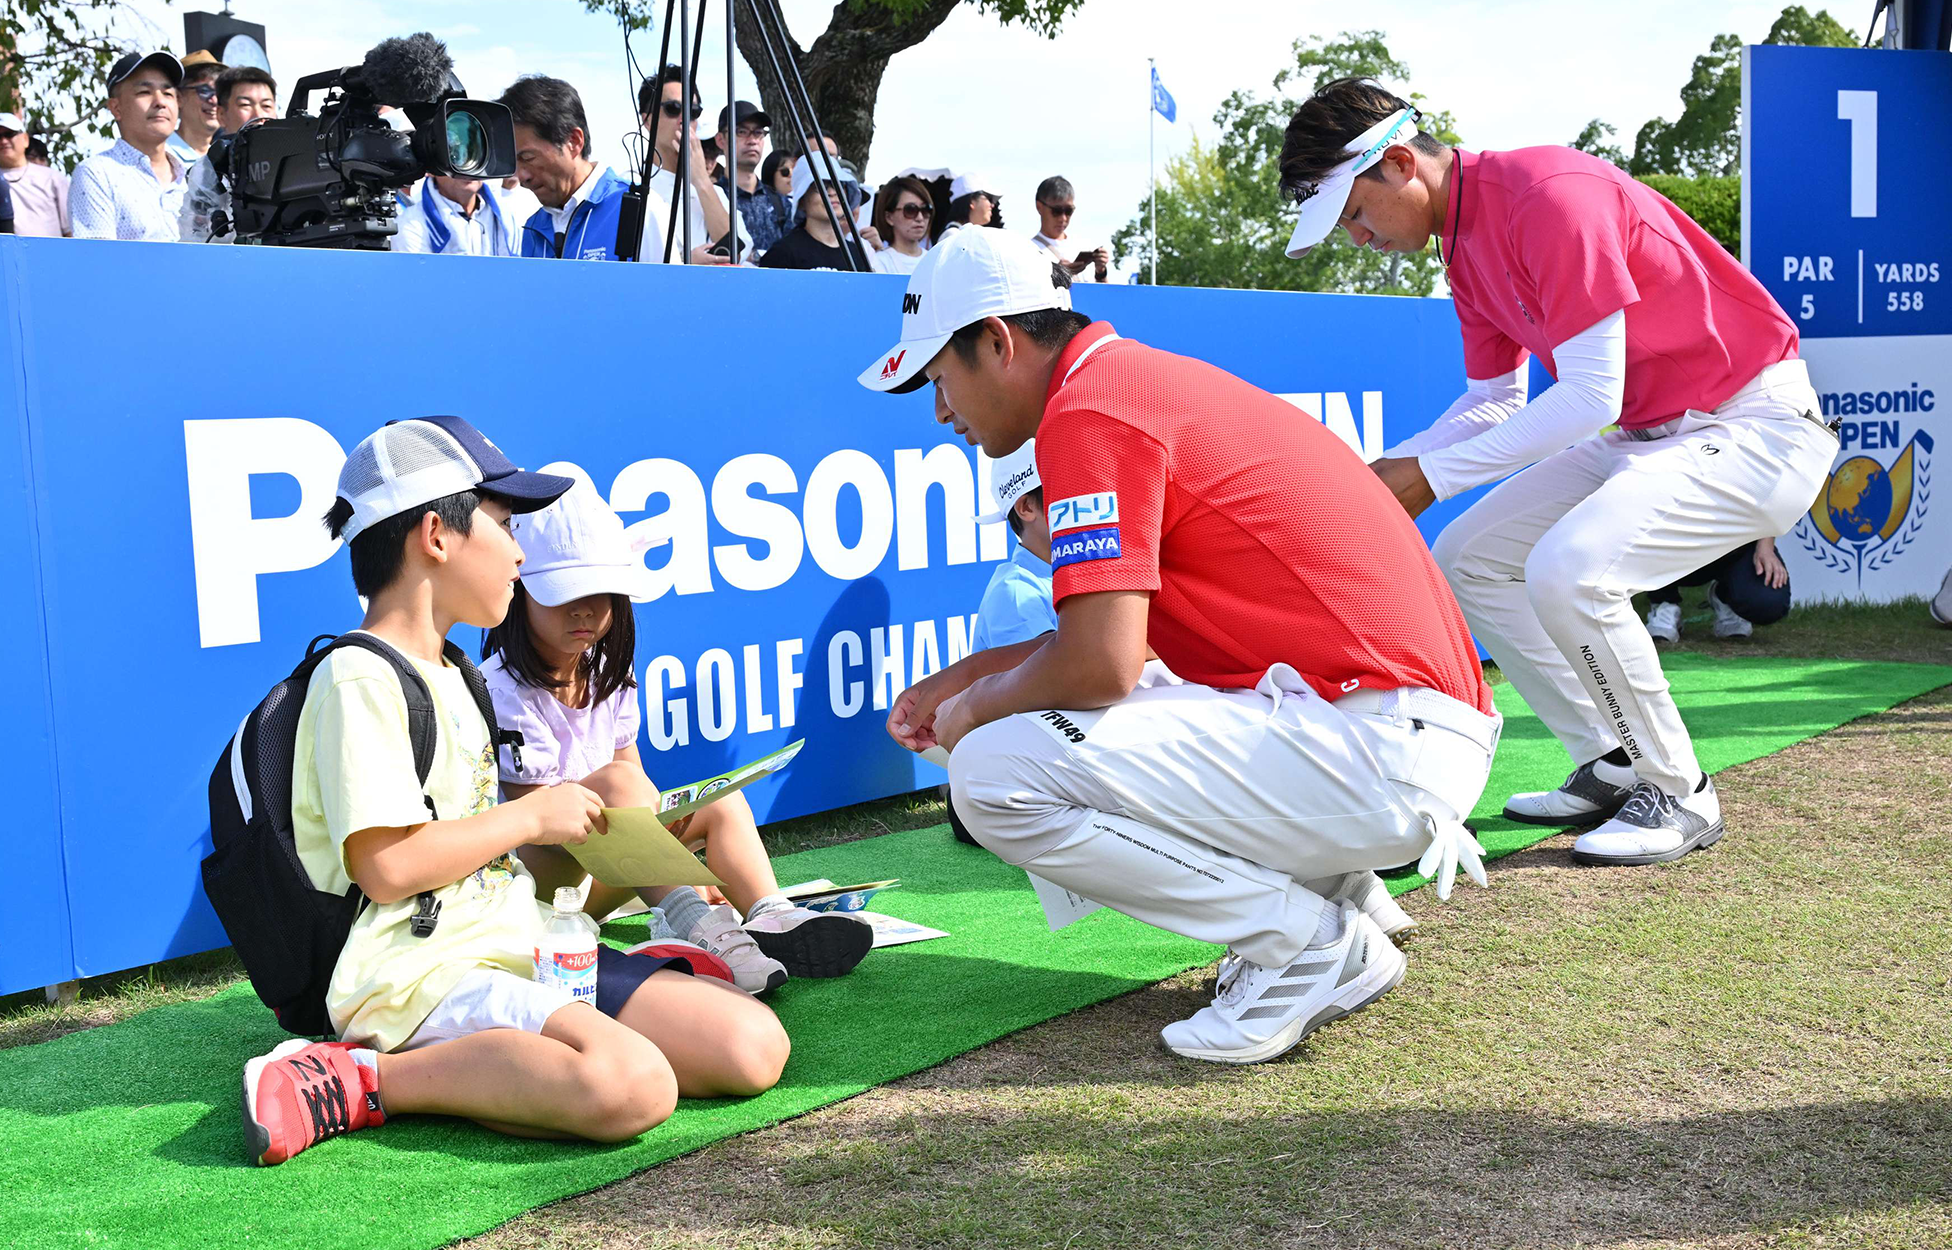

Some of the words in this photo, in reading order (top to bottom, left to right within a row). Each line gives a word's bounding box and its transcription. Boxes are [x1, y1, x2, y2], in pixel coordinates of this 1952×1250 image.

[316, 132, 334, 140] SOY
[1837, 89, 1878, 218] 1
[248, 161, 271, 182] MP
[1783, 256, 1835, 282] PAR
[1874, 263, 1940, 283] YARDS
[1800, 294, 1816, 320] 5
[1886, 291, 1924, 312] 558
[1818, 382, 1935, 416] nasonic
[1839, 420, 1900, 451] PEN
[998, 464, 1034, 499] Cleveland
[1007, 480, 1027, 499] GOLF
[1050, 496, 1115, 528] アトリ
[1051, 537, 1119, 562] MARAYA
[1580, 644, 1608, 686] EDITION
[645, 638, 804, 751] GOLF
[1601, 687, 1623, 720] BUNNY
[1040, 710, 1086, 743] TFW49
[1616, 720, 1643, 760] MASTER
